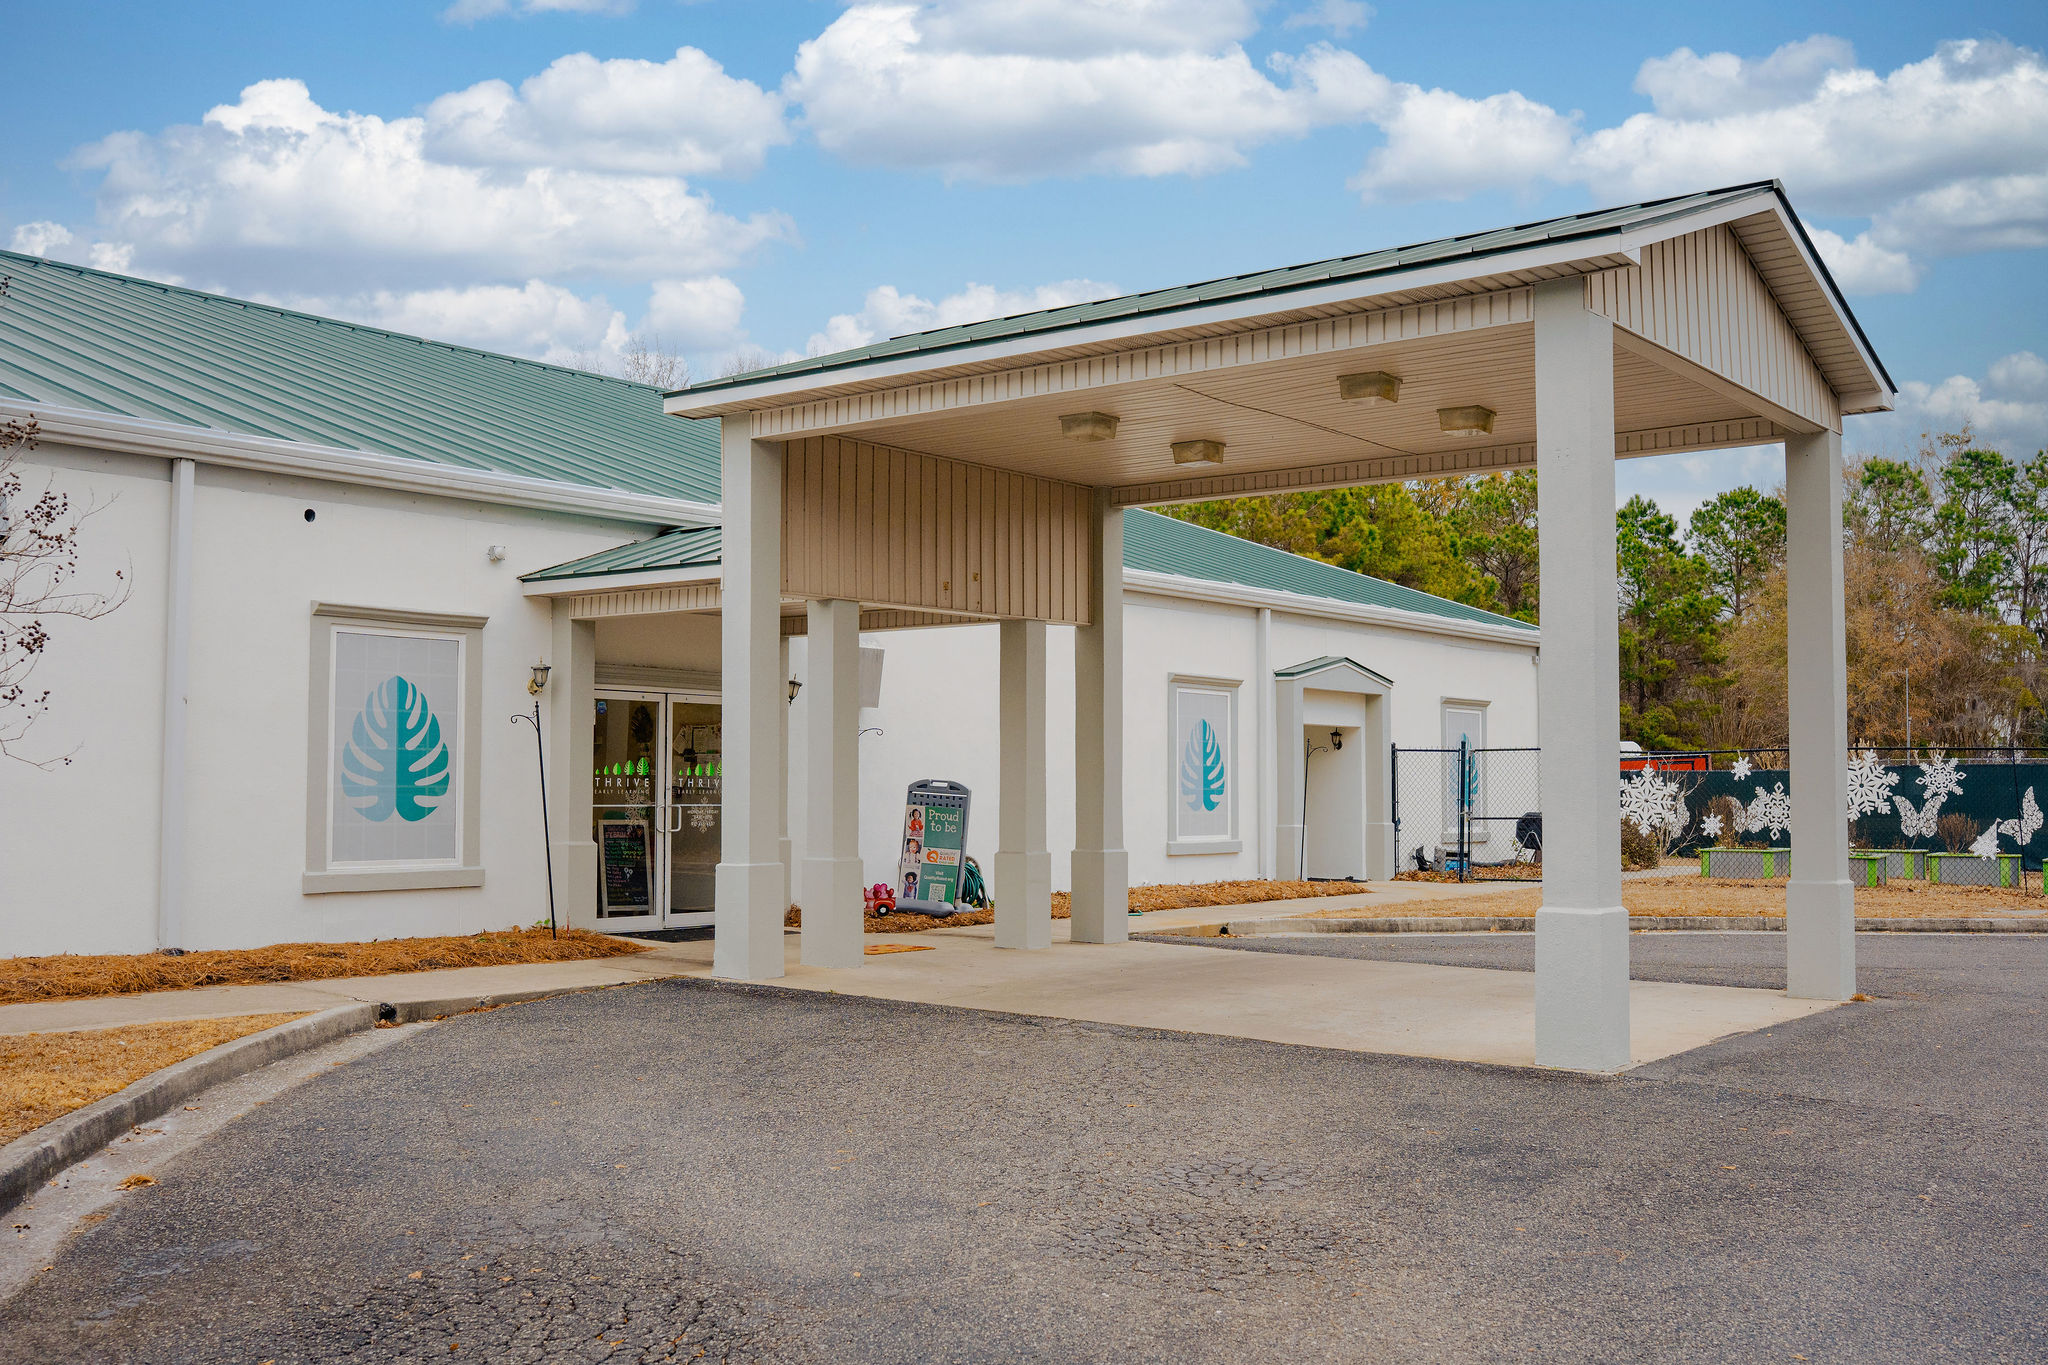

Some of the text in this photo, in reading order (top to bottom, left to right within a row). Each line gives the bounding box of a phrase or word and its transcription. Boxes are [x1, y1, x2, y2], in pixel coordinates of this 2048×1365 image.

[595, 778, 650, 787] THRIVE
[678, 778, 720, 787] THRIV
[929, 809, 959, 821] Proud
[931, 821, 956, 832] to be
